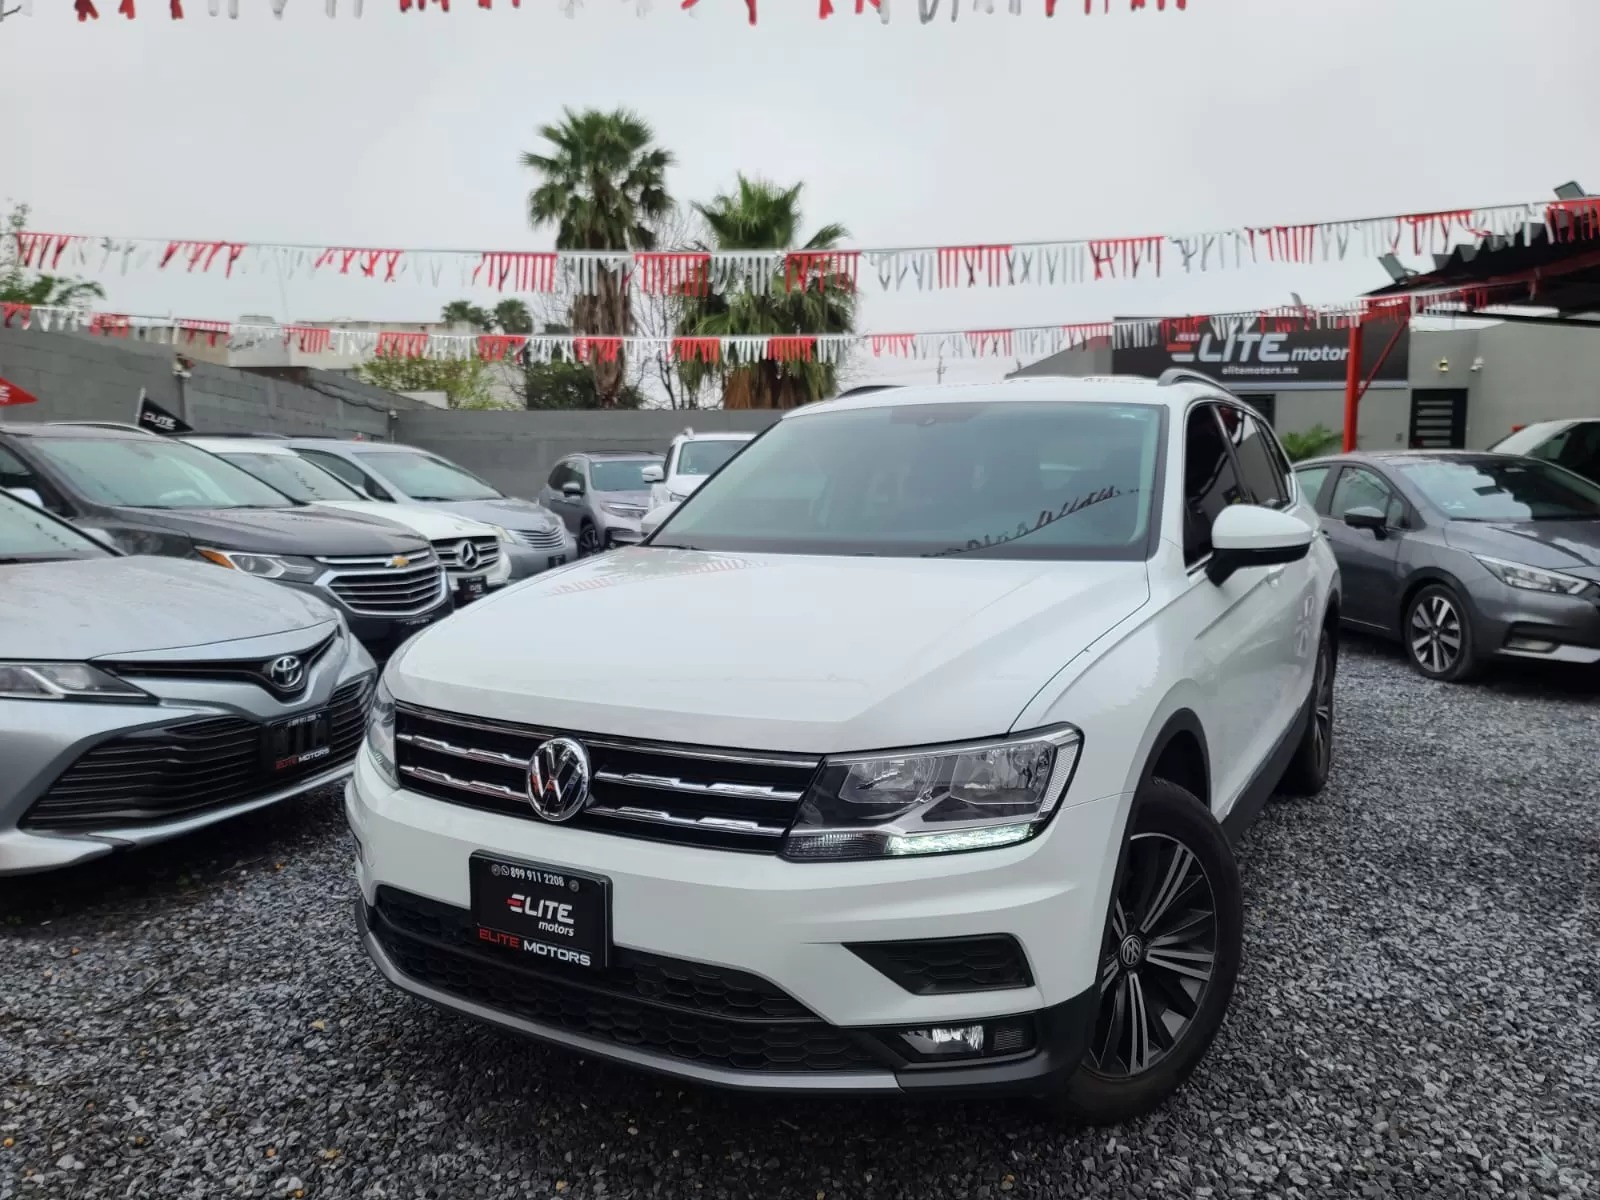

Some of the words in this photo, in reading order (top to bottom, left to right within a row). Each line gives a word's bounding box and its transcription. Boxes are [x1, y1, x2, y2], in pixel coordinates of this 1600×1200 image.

[1166, 333, 1290, 362] ELITE
[1291, 345, 1350, 361] motor
[1221, 365, 1299, 375] elitemotors.mx
[510, 867, 526, 880] 899
[526, 870, 542, 883] 911
[543, 873, 565, 887] 2208
[506, 893, 575, 925] ELITE
[538, 920, 575, 937] motors
[479, 928, 520, 948] ELITE
[523, 940, 591, 967] MOTORS
